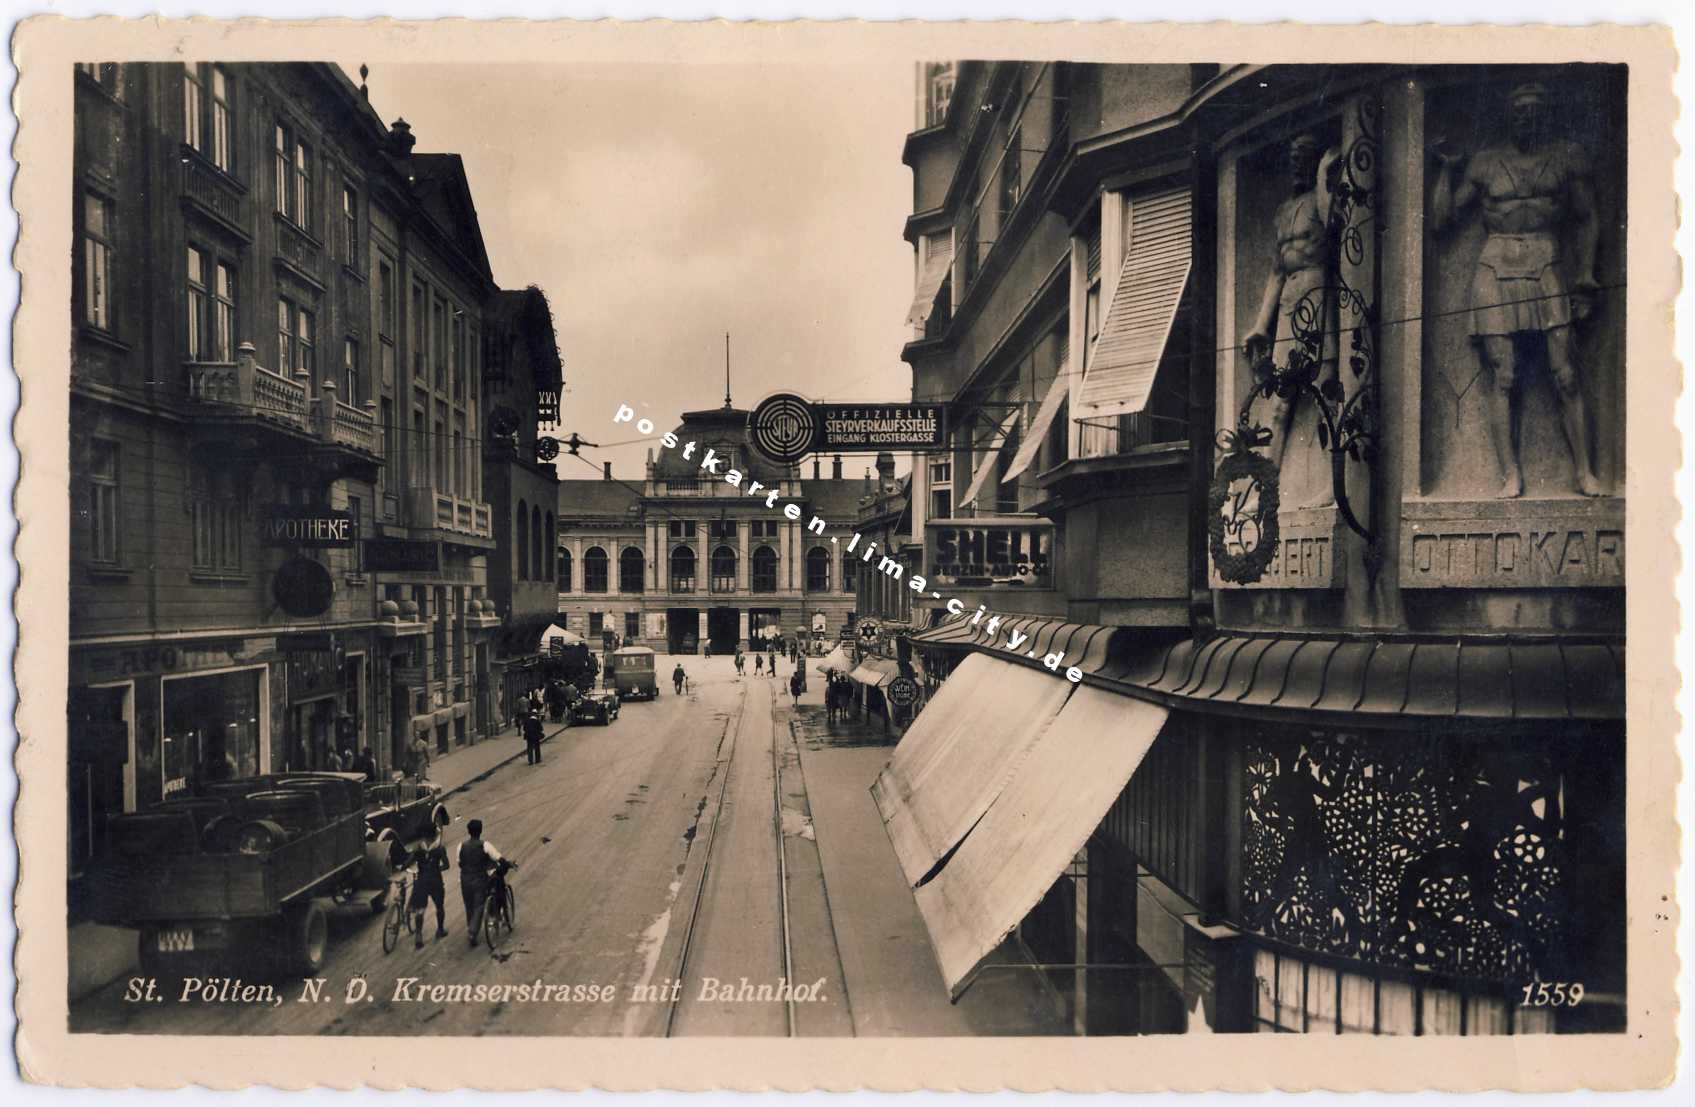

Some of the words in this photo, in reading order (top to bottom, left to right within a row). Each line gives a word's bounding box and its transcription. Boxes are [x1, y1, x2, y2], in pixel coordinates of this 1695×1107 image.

[827, 409, 934, 419] OFFIZIELLE
[825, 419, 937, 432] STEYRVERKAUFSSTELLE
[827, 433, 866, 444] EINGANG
[870, 432, 935, 443] KLOSTERGASSE
[264, 518, 351, 541] APOTHEKE
[936, 528, 1048, 564] SHELL
[1410, 529, 1625, 575] OTTOKAR
